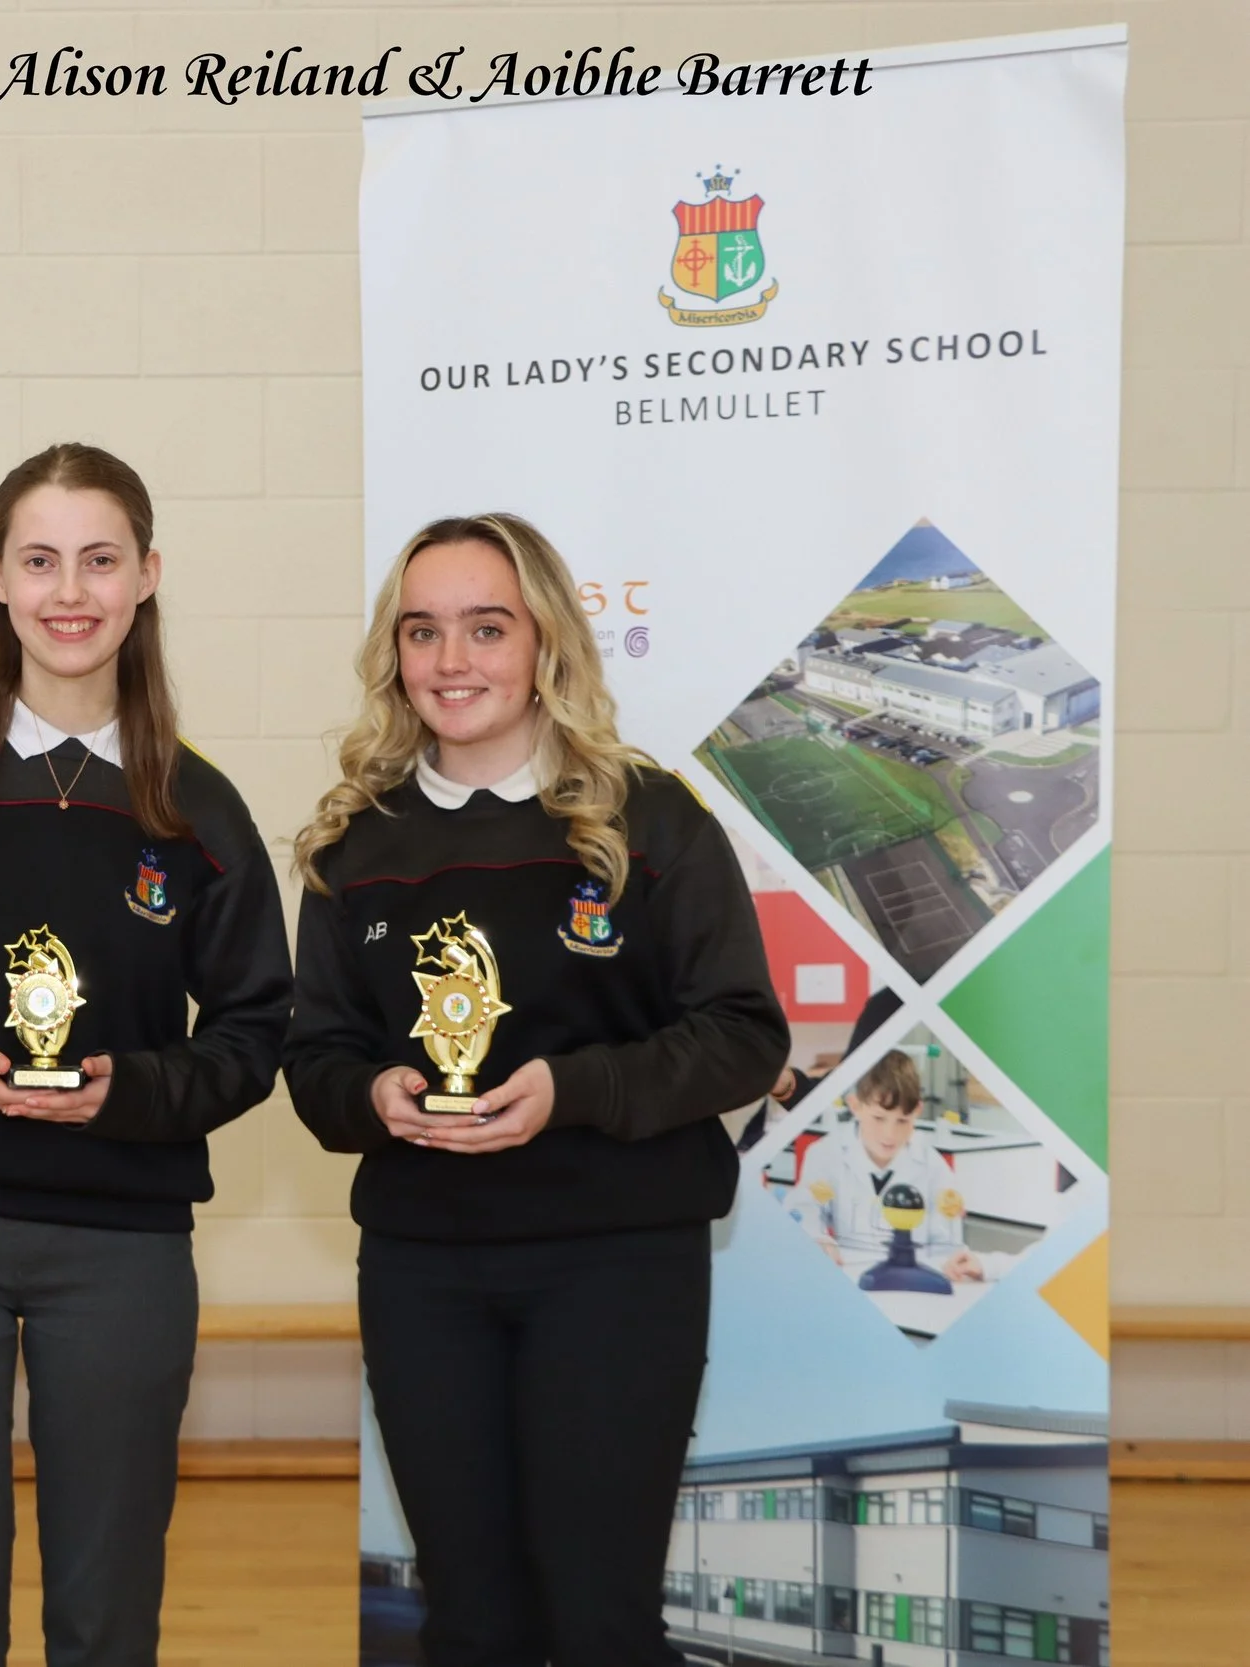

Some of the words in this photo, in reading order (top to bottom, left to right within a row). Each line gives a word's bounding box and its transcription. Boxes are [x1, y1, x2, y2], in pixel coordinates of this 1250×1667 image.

[420, 364, 490, 392] OUR
[507, 353, 628, 386] LADY'S
[644, 340, 869, 379] SECONDARY
[886, 329, 1047, 364] SCHOOL
[616, 390, 826, 426] BELMULLET
[364, 921, 388, 945] AB
